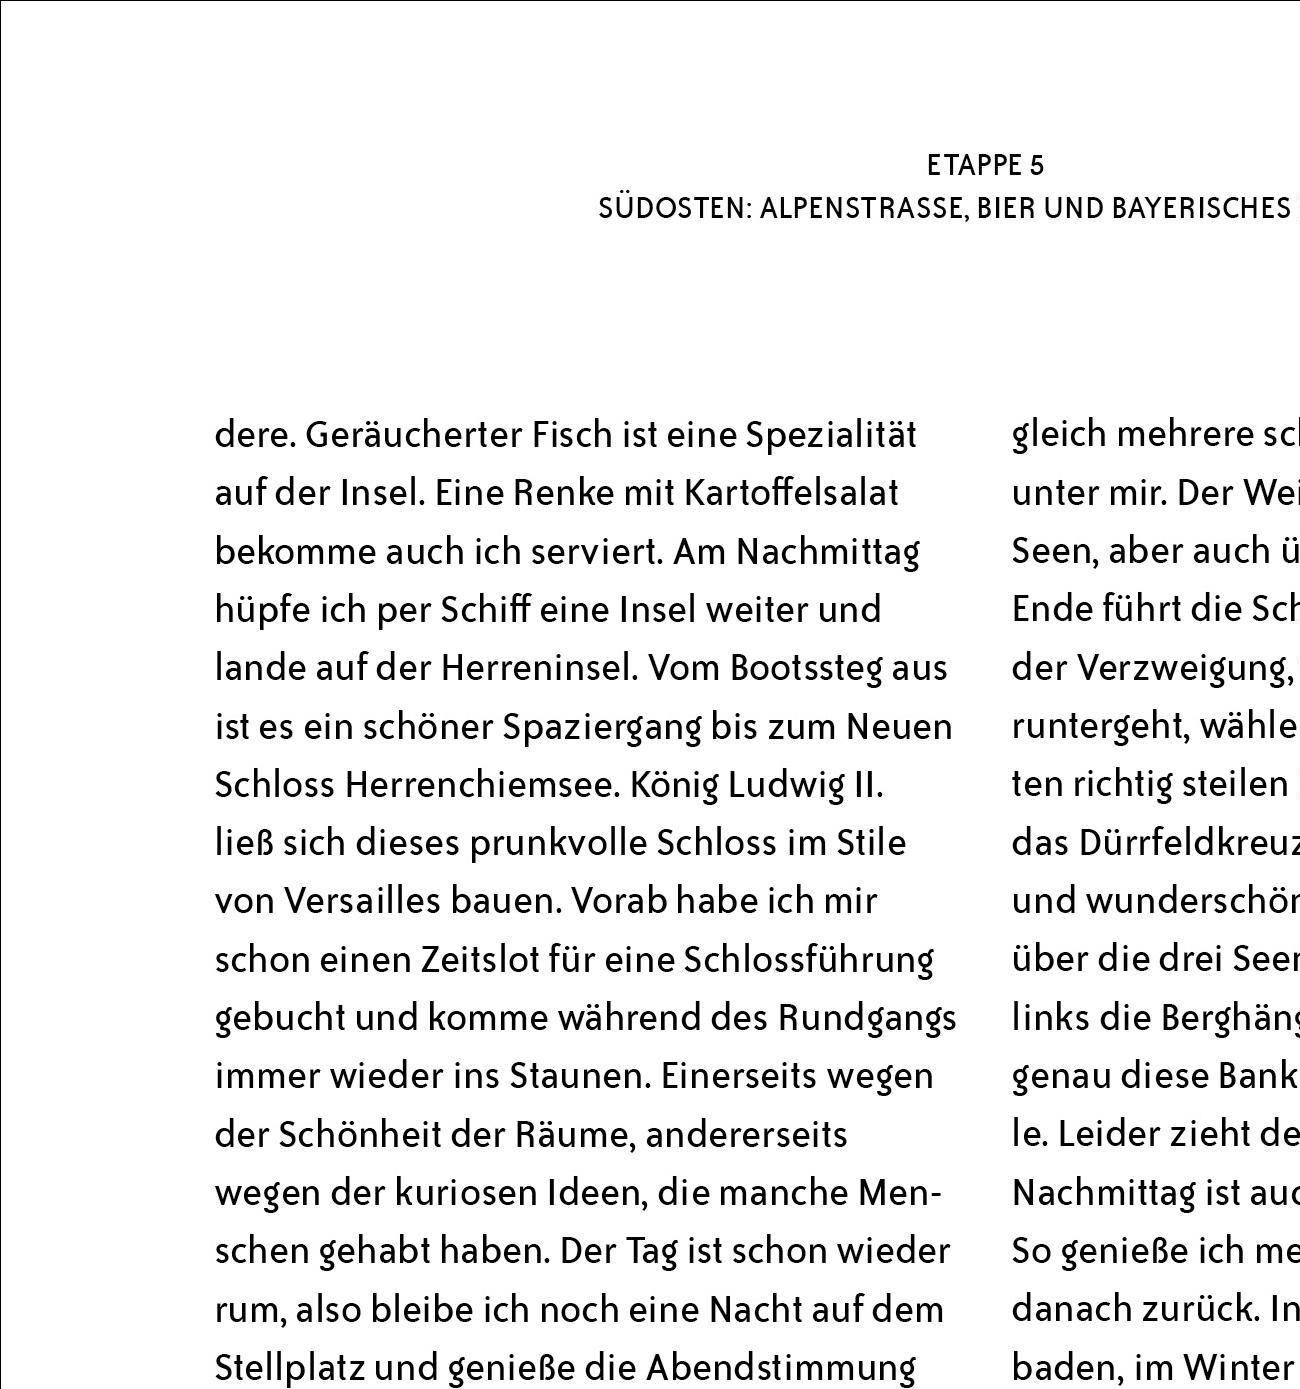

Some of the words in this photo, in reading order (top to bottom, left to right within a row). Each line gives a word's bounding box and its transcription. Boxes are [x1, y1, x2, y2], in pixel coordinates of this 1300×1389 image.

[928, 153, 1022, 176] ETAPPE
[1030, 154, 1044, 176] 5
[598, 189, 752, 219] SÜDOSTEN:
[759, 196, 970, 223] ALPENSTRASSE,
[978, 196, 1035, 219] BIER
[1045, 196, 1104, 219] UND
[1113, 196, 1291, 219] BAYERISCHES
[215, 417, 296, 448] dere.
[306, 417, 523, 448] Geräucherter
[534, 417, 612, 448] Fisch
[624, 420, 658, 448] ist
[667, 420, 737, 448] eine
[746, 417, 917, 456] Spezialität
[215, 767, 334, 798] Schloss
[347, 767, 620, 798] Herrenchiemsee.
[632, 770, 720, 806] König
[730, 767, 846, 806] Ludwig
[856, 770, 883, 798] II.
[1012, 825, 1068, 856] das
[1014, 1175, 1197, 1214] Nachmittag
[1207, 1178, 1241, 1206] ist
[215, 1350, 365, 1389] Stellplatz
[375, 1350, 438, 1381] und
[448, 1353, 575, 1389] genieße
[585, 1350, 636, 1381] die
[645, 1350, 917, 1389] Abendstimmung
